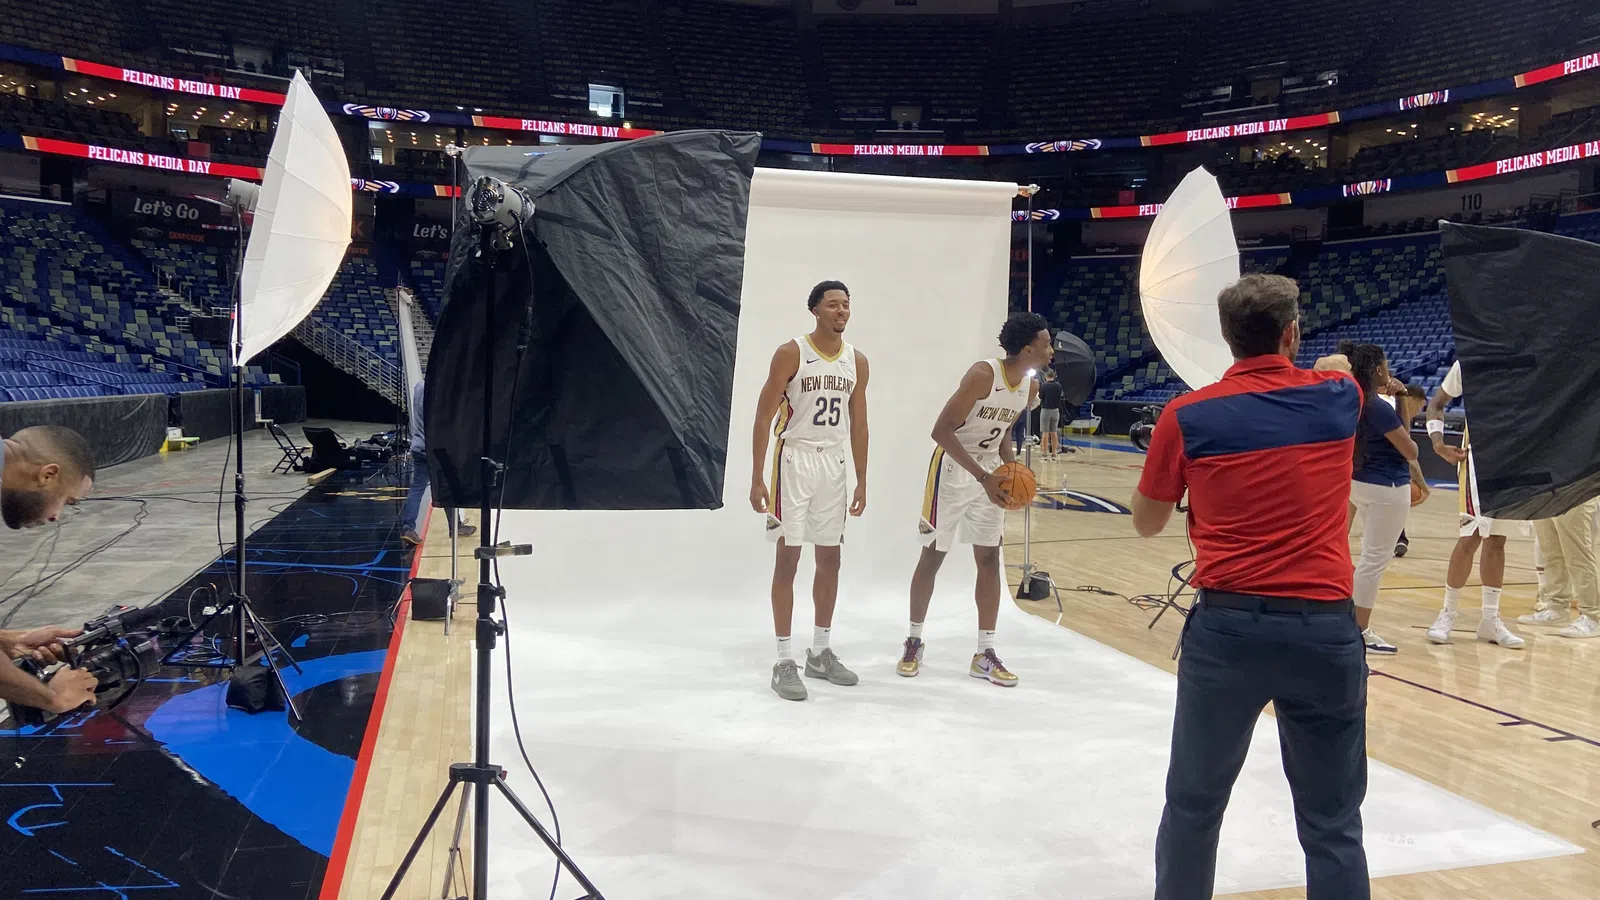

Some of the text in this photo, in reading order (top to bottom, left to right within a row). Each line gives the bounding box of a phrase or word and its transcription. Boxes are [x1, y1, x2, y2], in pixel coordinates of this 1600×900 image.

[1563, 53, 1600, 75] PELICA
[122, 69, 242, 99] PELICANS MEDIA DAY
[521, 119, 619, 138] PELICANS MEDIA DAY
[1186, 118, 1288, 142] PELICANS MEDIA DAY
[88, 145, 211, 174] PELICANS MEDIA DAY
[853, 145, 944, 156] PELICANS MEDIA DAY
[1496, 140, 1600, 174] PELICANS MEDIA DA
[133, 197, 199, 220] Let's Go
[1138, 197, 1239, 216] PELI AY
[1461, 193, 1482, 211] 110
[412, 223, 448, 239] Let's
[801, 375, 821, 393] NEW
[812, 396, 841, 427] 25
[976, 405, 1017, 423] NEW ORLE
[978, 427, 1002, 449] 2
